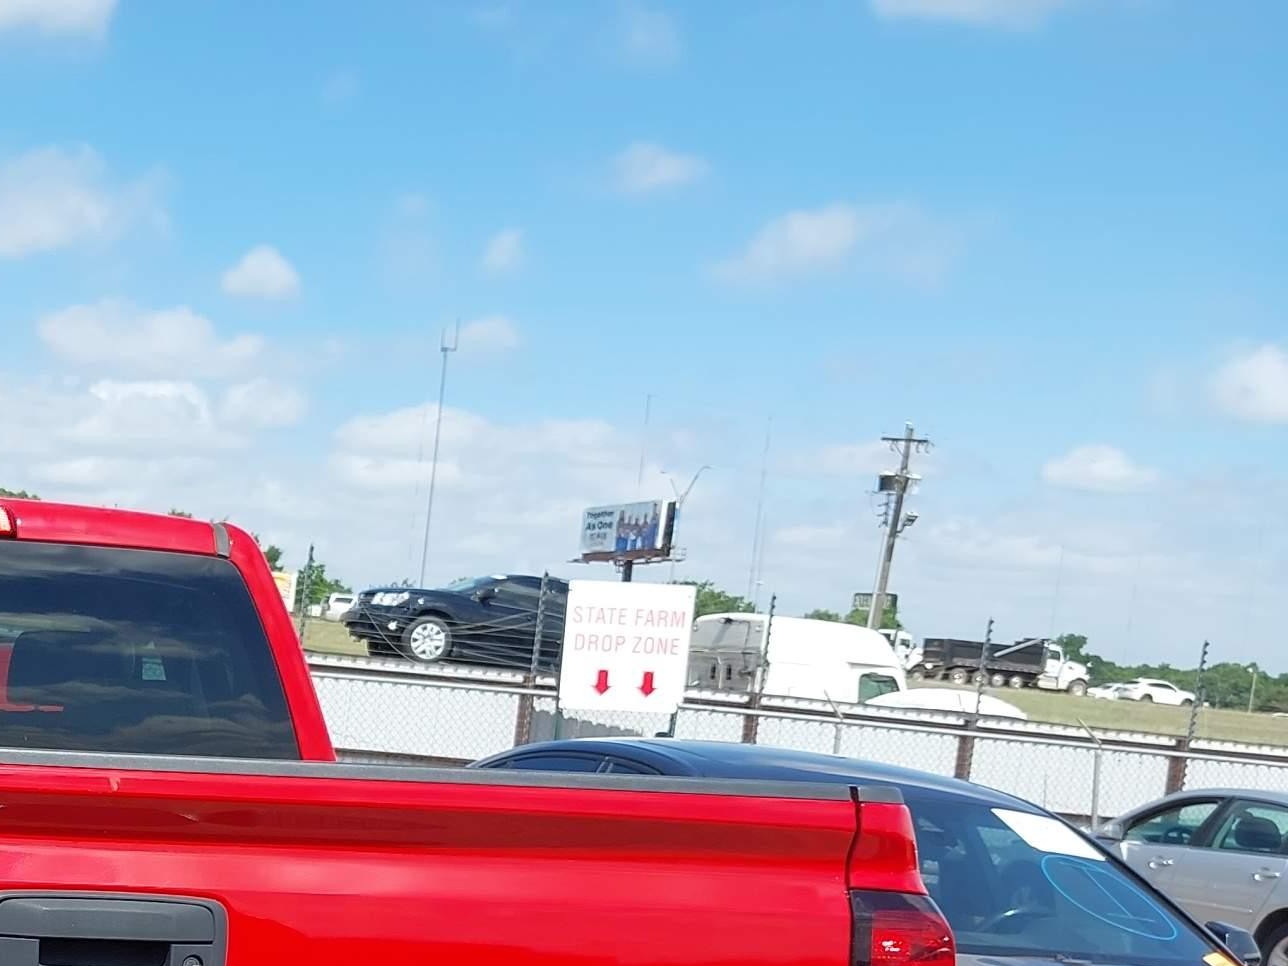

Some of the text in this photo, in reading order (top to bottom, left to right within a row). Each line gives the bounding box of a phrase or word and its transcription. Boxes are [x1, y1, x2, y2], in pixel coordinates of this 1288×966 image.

[597, 521, 613, 530] One
[572, 605, 686, 628] STATE FARM
[574, 633, 680, 656] DROP ZONE
